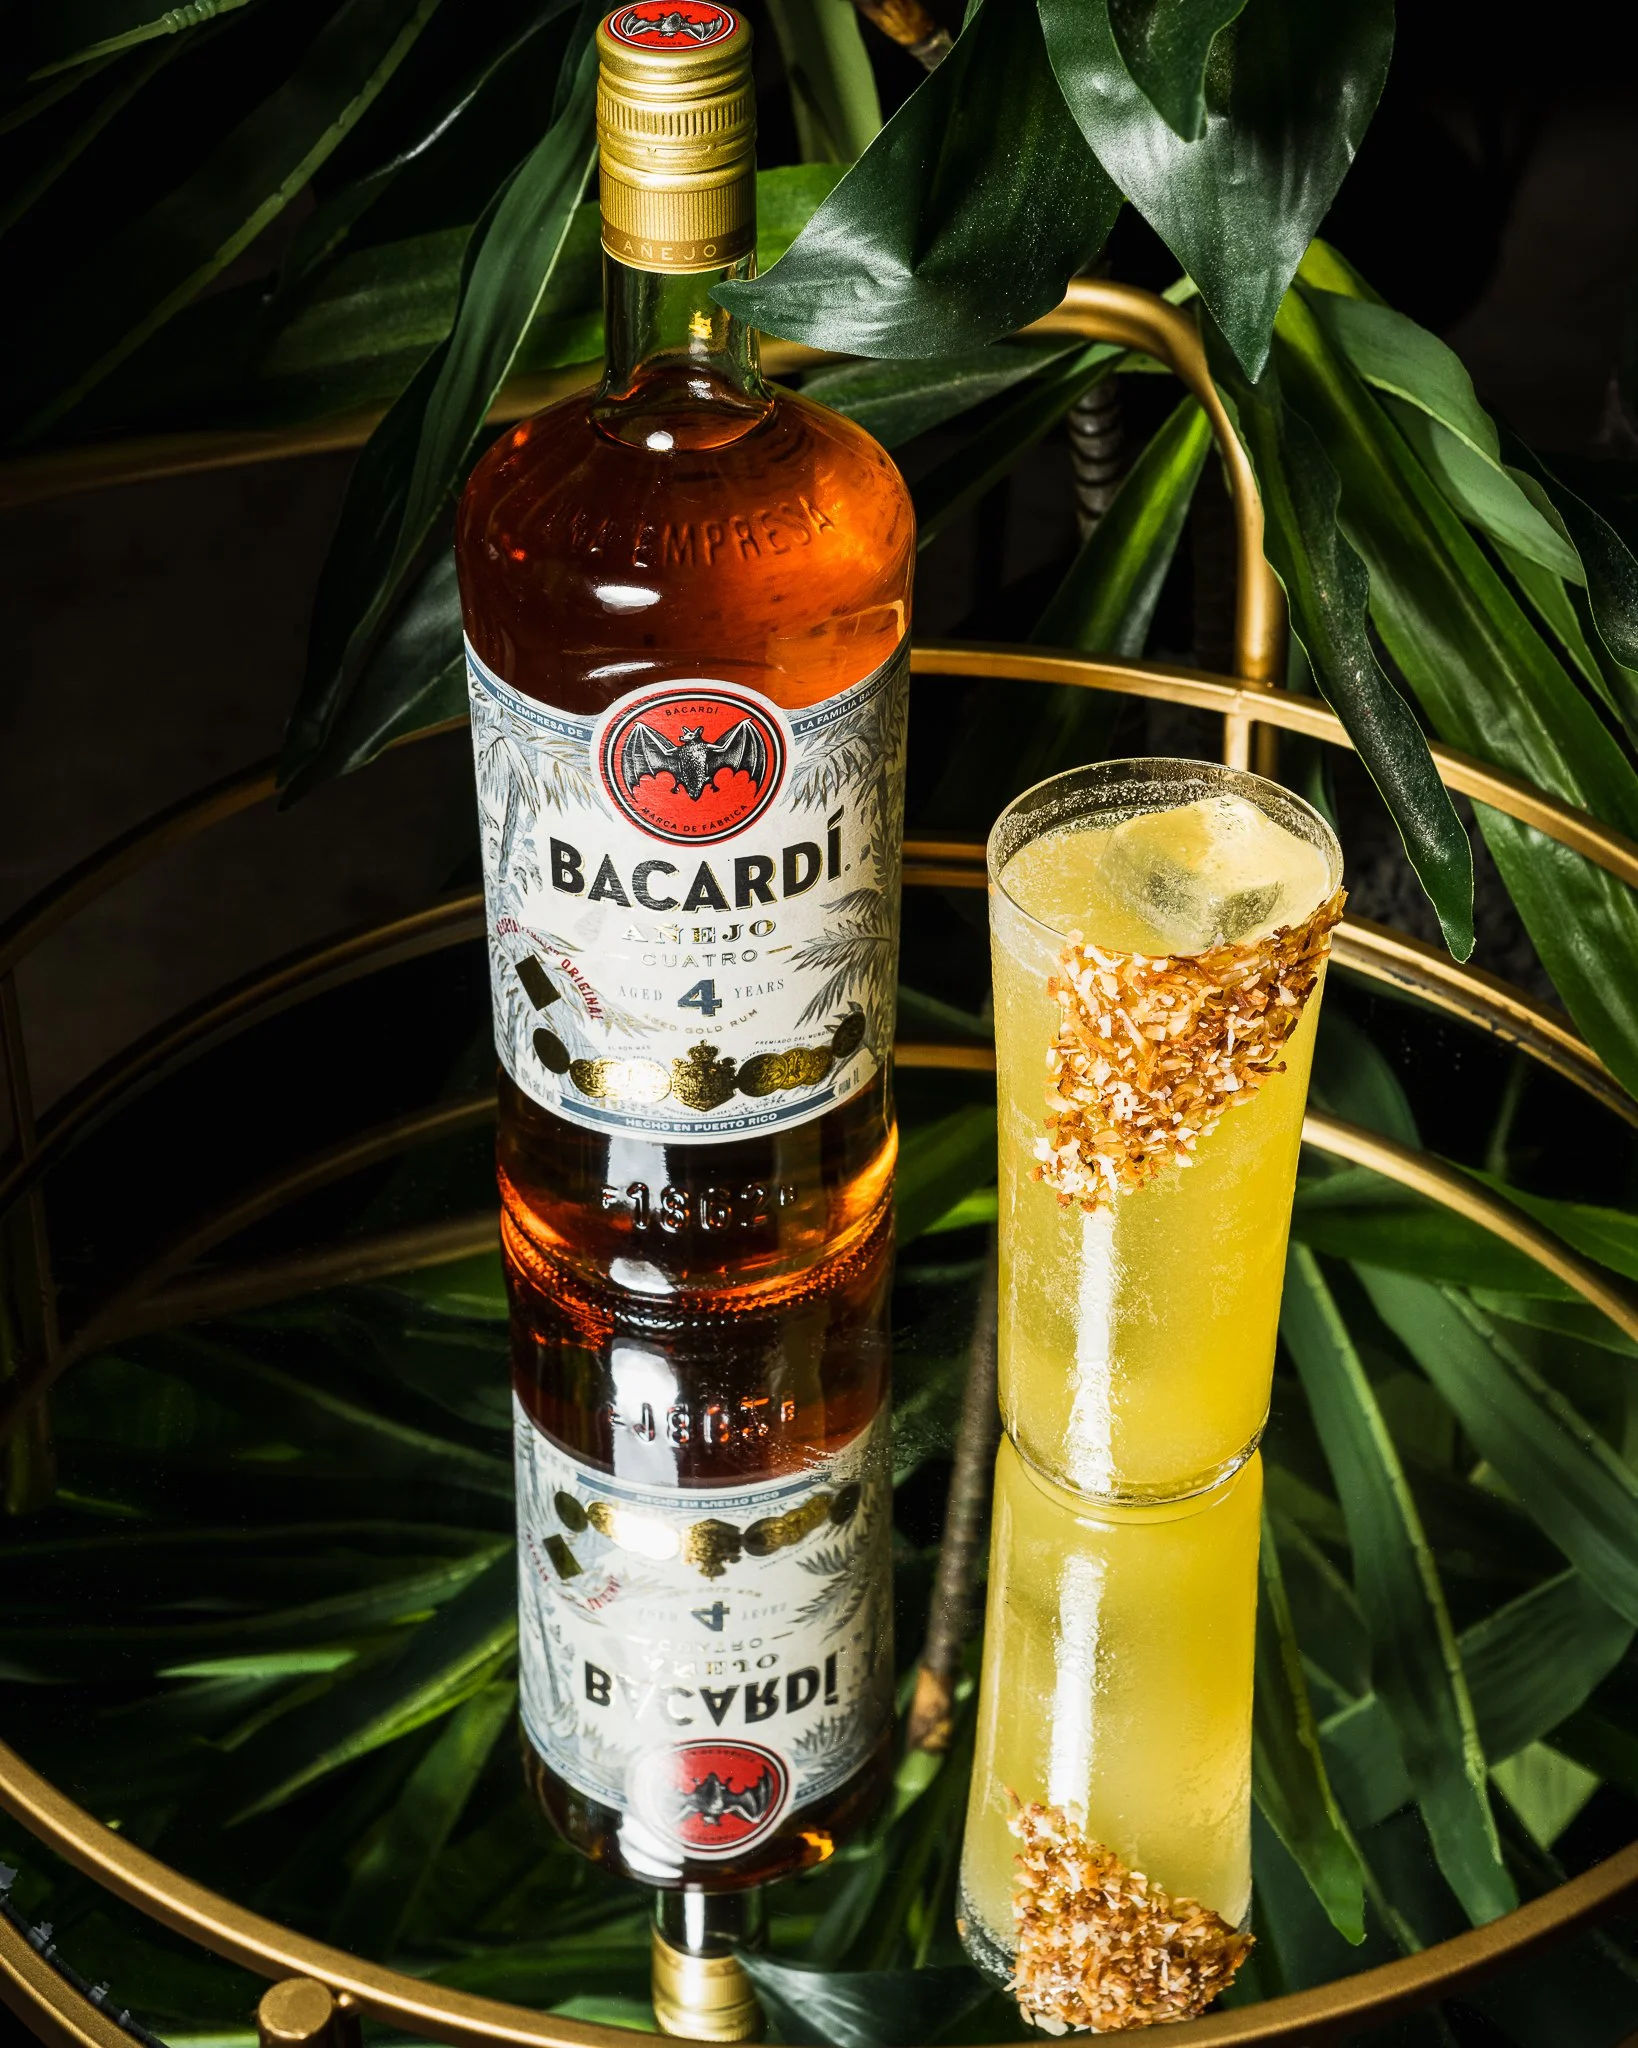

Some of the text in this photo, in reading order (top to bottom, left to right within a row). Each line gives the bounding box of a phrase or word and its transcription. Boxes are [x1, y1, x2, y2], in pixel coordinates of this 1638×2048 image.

[623, 240, 717, 261] AÑEJO
[632, 496, 836, 568] EMPRESA
[496, 690, 584, 738] UNA EMPRESA DE
[665, 706, 719, 716] BACARDÍ
[800, 721, 814, 732] LA
[817, 700, 857, 725] FAMILIA
[641, 806, 677, 831] MARCA
[702, 804, 748, 831] FÁBRICA
[549, 804, 845, 914] BACARDÍ
[621, 919, 777, 945] AÑEJO
[641, 949, 758, 968] CUATRO
[561, 958, 604, 1020] ORIGINAL
[618, 978, 785, 1017] AGED 4 YEARS
[685, 1025, 723, 1035] GOLD
[730, 1008, 759, 1027] RUM
[625, 1112, 778, 1132] HECHO EN PUERTO RICO
